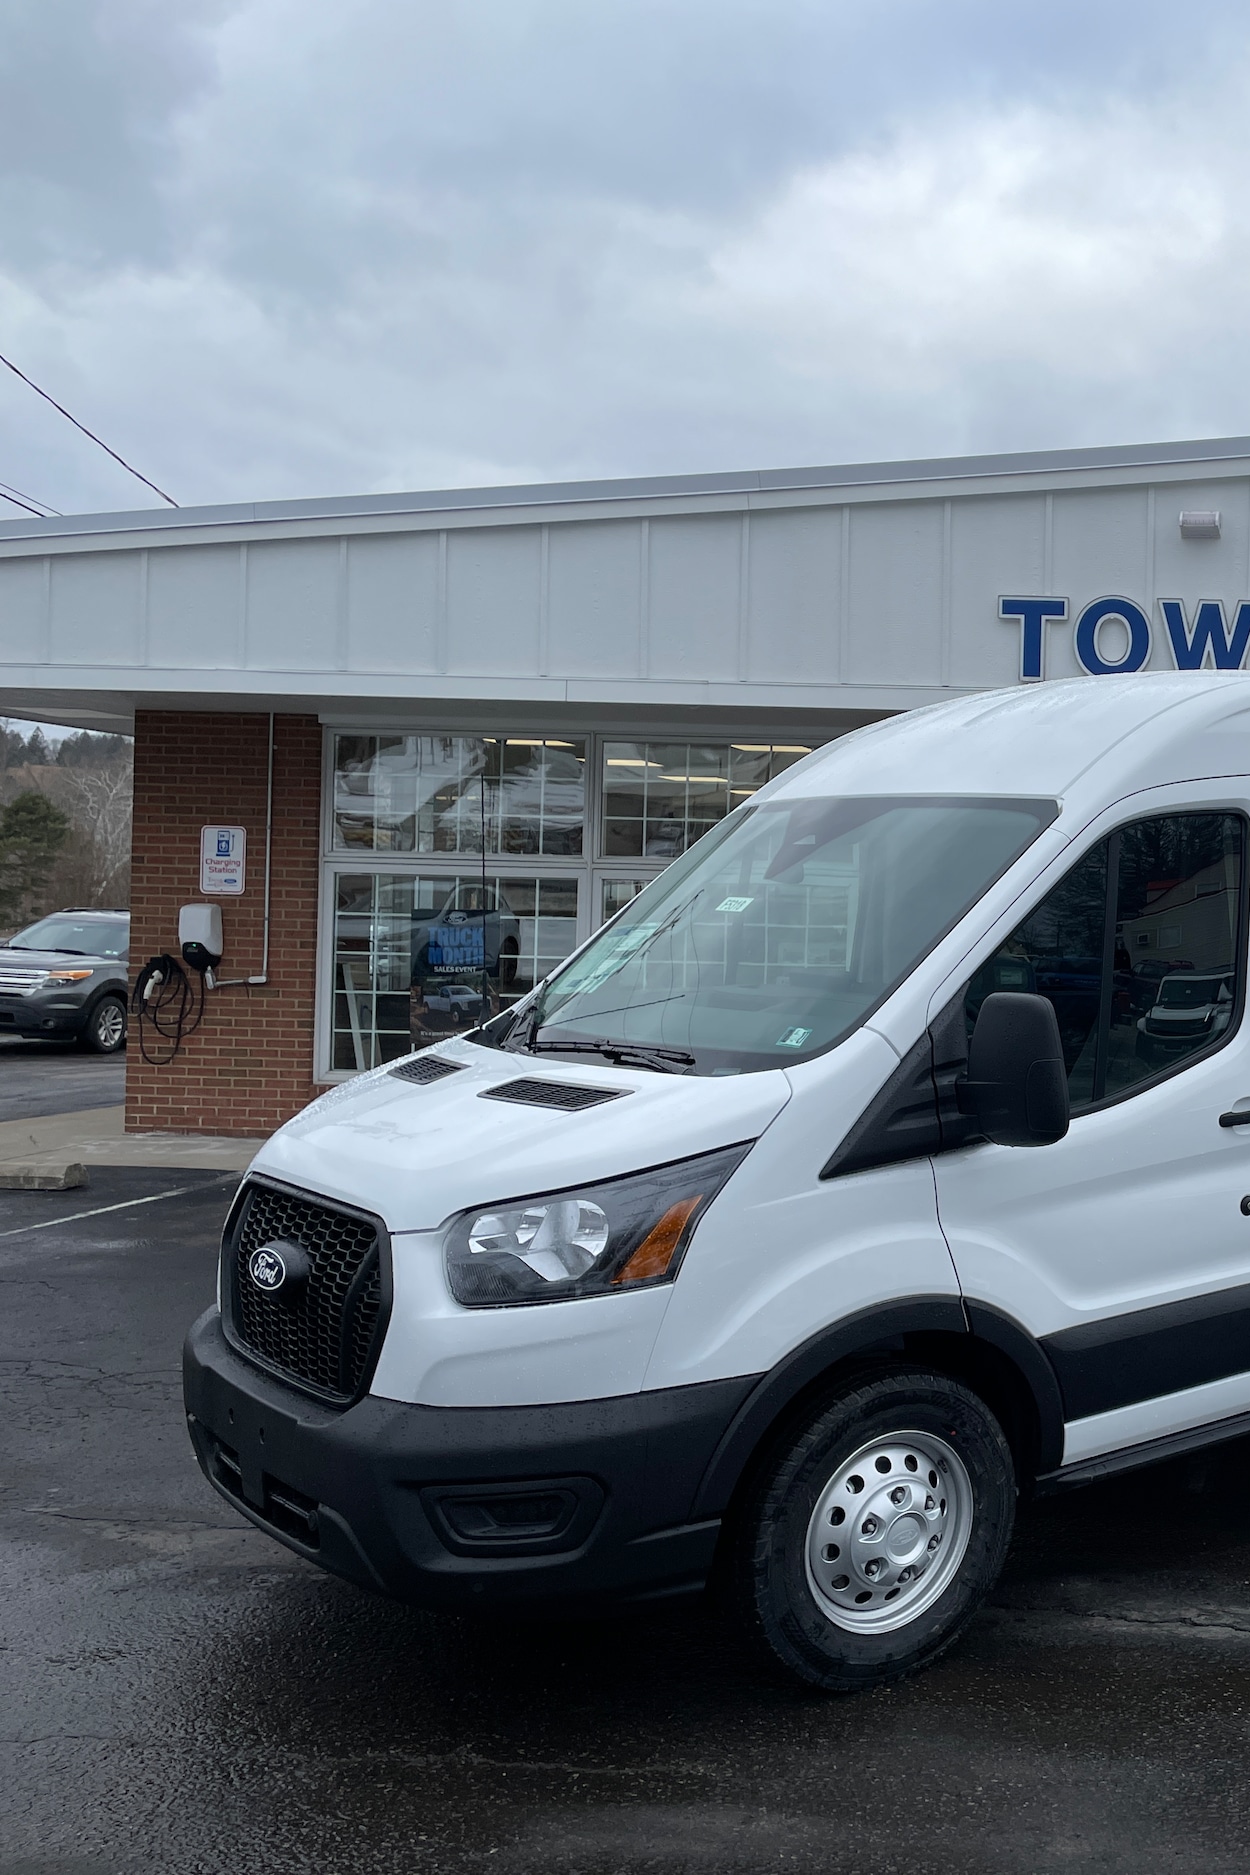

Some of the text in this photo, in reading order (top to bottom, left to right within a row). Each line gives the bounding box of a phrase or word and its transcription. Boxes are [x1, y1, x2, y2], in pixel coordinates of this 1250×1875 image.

[205, 858, 241, 867] Charging
[208, 866, 238, 874] Station
[428, 927, 484, 946] TRUCK
[428, 946, 484, 964] MONTH
[434, 966, 476, 974] SALES EVENT
[254, 1253, 278, 1284] Ford
